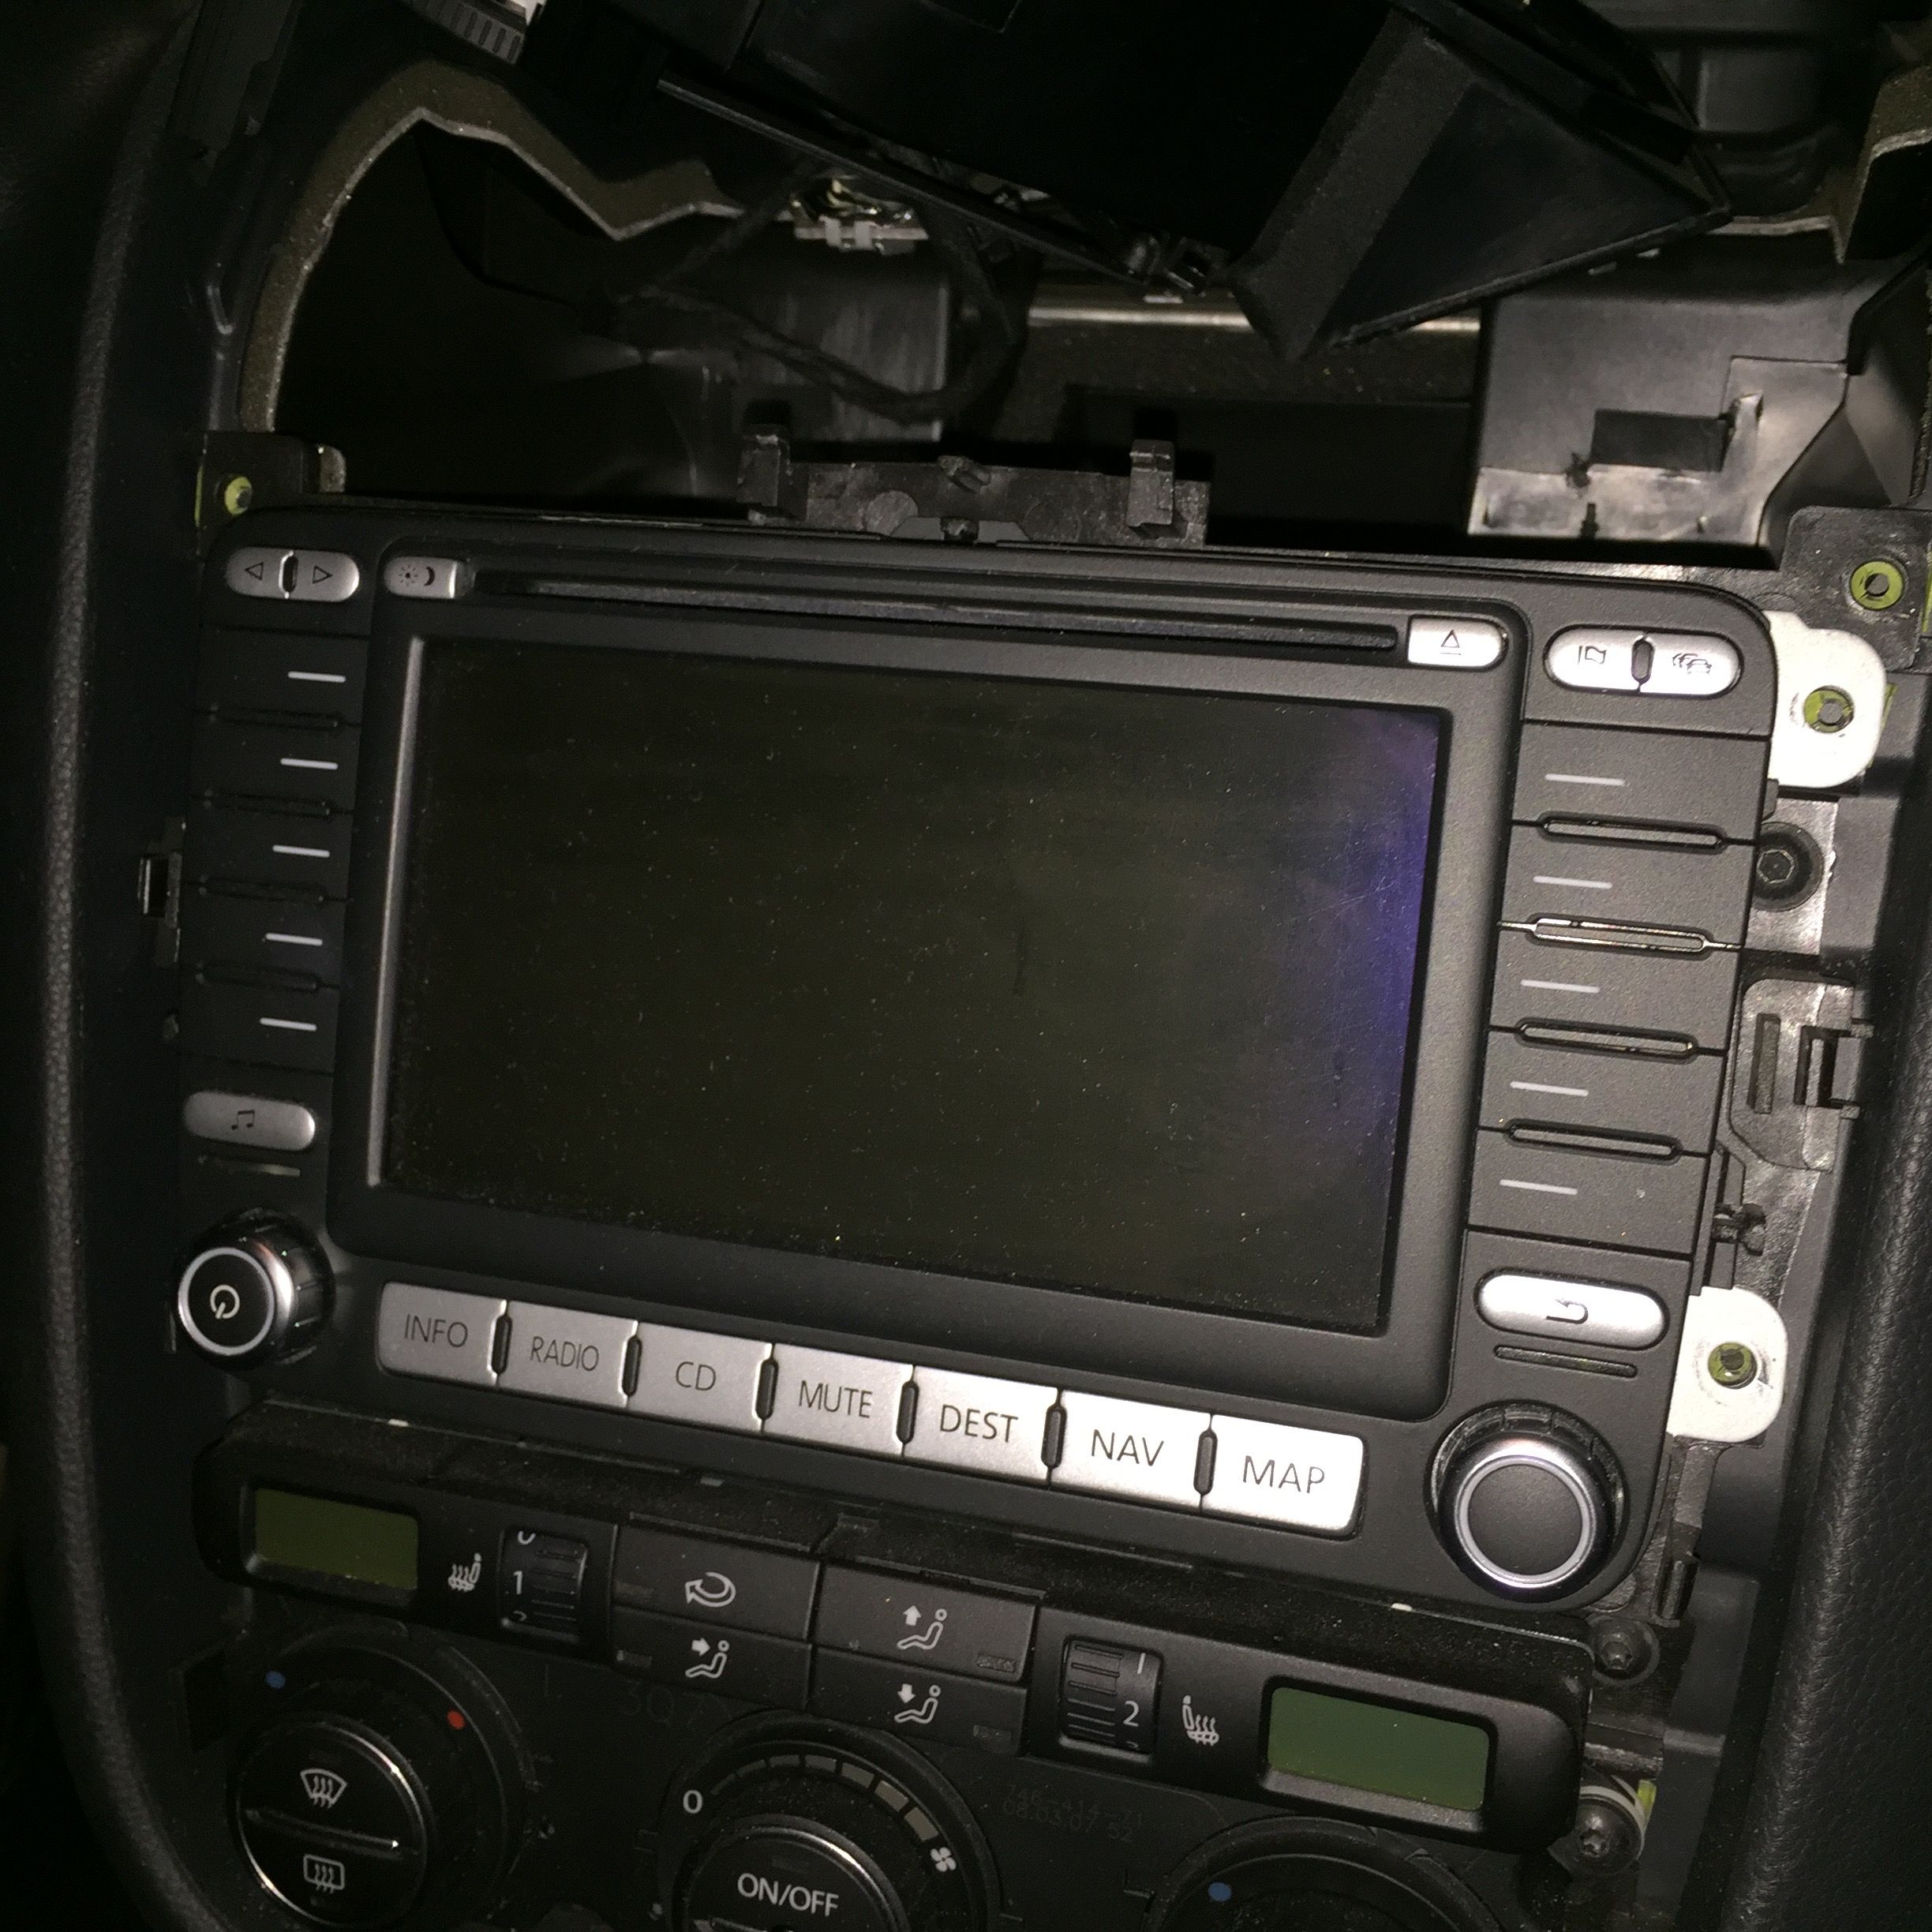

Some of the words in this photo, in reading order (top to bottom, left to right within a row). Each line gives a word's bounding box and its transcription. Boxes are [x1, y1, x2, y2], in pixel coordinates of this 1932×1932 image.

[403, 1314, 469, 1348] INFO
[530, 1335, 599, 1372] RADIO
[675, 1361, 717, 1391] CD
[798, 1380, 873, 1419] MUTE
[939, 1404, 1019, 1443] DEST
[1091, 1428, 1165, 1467] NAV
[1242, 1455, 1325, 1494] MAP
[513, 1570, 523, 1595] 1
[1123, 1700, 1140, 1727] 2
[737, 1873, 839, 1916] ON/OFF
